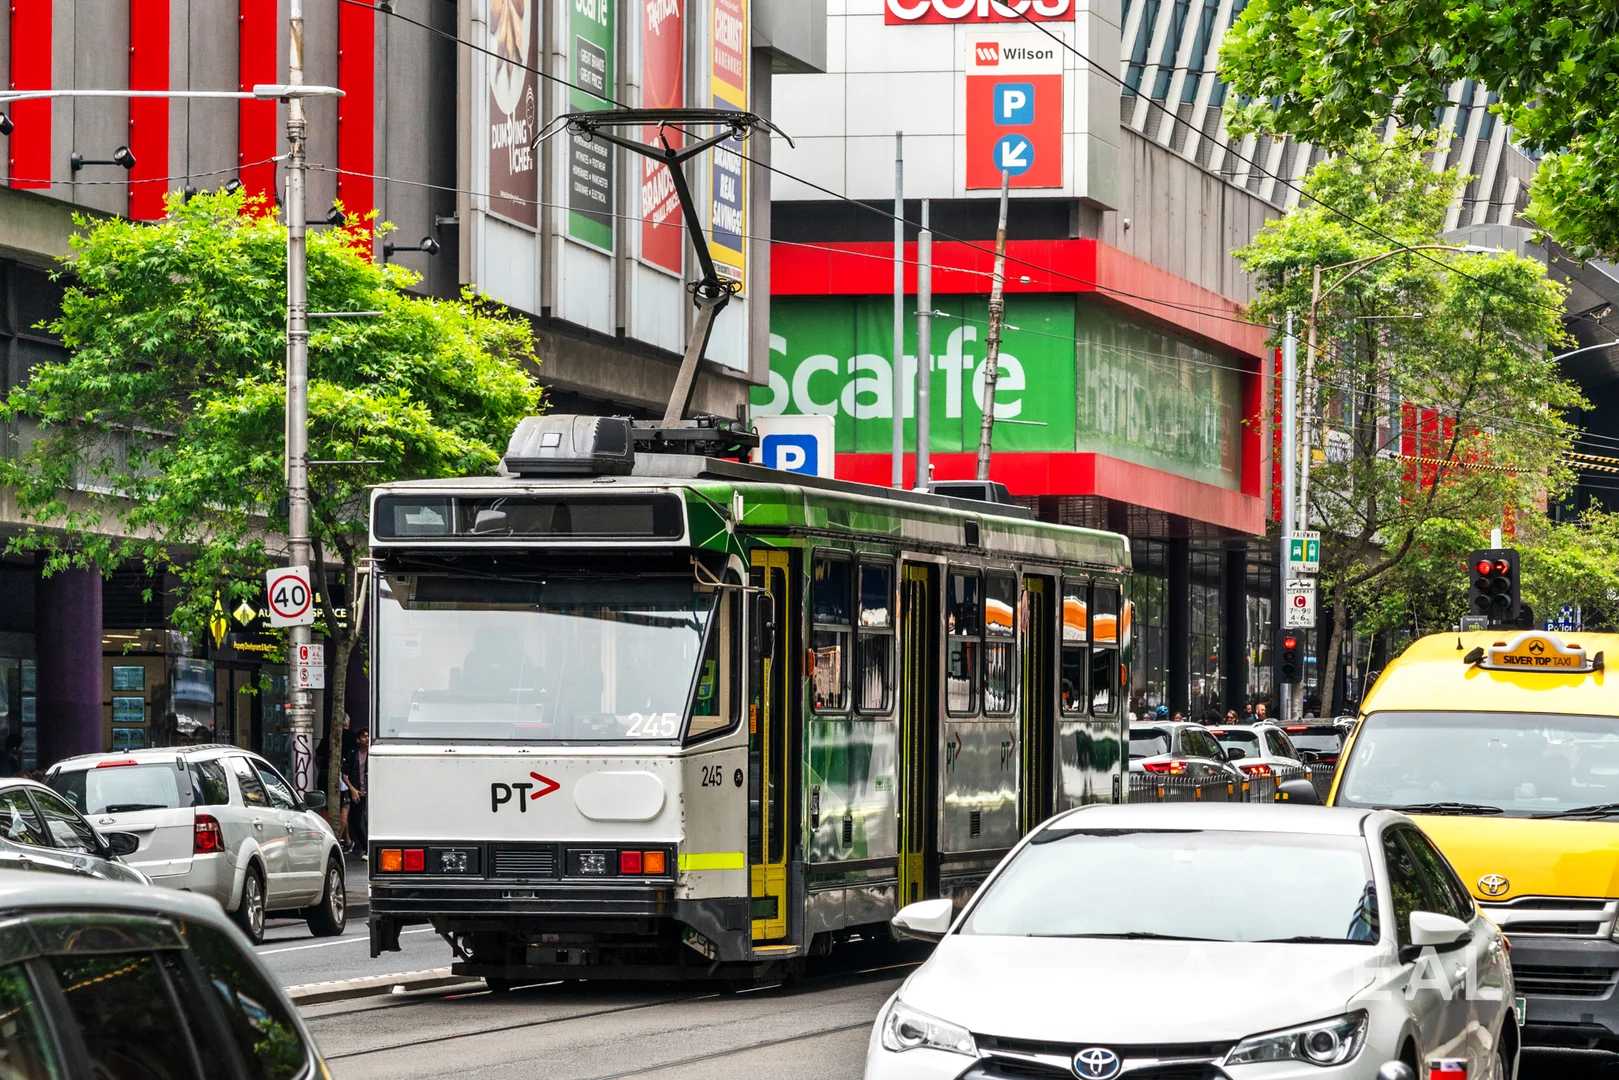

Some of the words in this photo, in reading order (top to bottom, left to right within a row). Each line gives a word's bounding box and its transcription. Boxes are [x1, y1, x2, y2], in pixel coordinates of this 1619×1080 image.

[715, 7, 743, 54] CHEMIST
[1003, 48, 1054, 60] Wilson
[1003, 90, 1026, 118] P
[719, 173, 735, 203] REAL
[776, 445, 806, 476] P
[1292, 531, 1319, 539] FAIRWAY
[274, 585, 306, 608] 40
[1547, 623, 1572, 632] Poic
[1503, 655, 1533, 665] SILVER
[1534, 656, 1552, 665] TOP
[1553, 656, 1572, 666] TAXI
[625, 712, 677, 738] 245
[701, 765, 722, 787] 245
